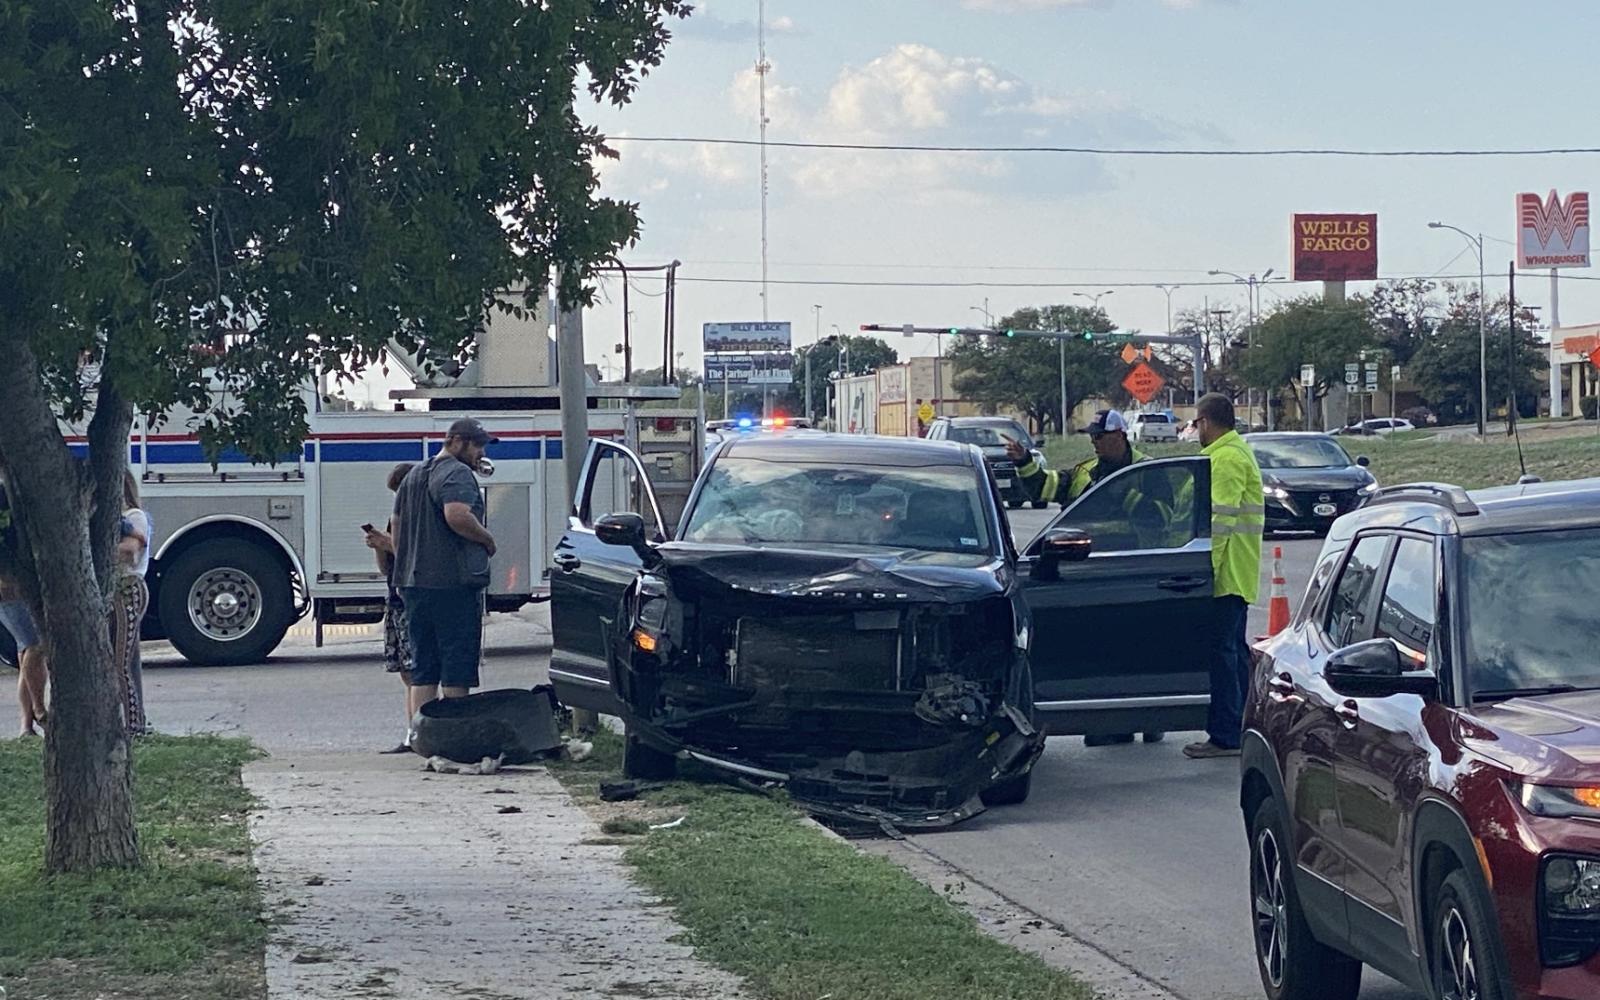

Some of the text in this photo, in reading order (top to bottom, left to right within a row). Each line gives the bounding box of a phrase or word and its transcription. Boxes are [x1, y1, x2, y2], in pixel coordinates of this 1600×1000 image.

[1300, 220, 1369, 235] WELLS
[1302, 236, 1370, 251] FARGO
[1525, 254, 1586, 265] WHATABURGER
